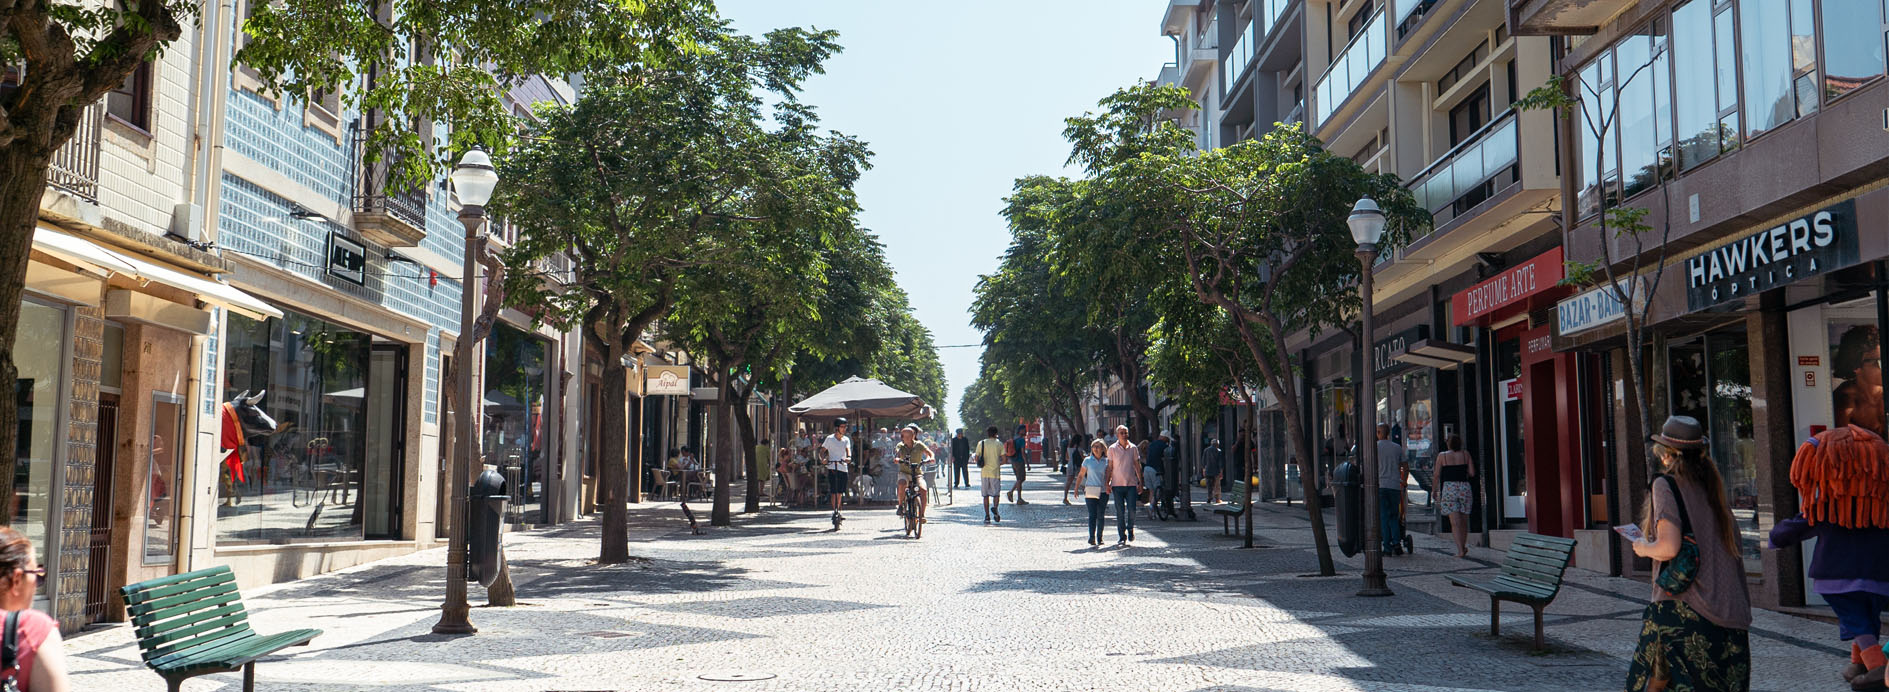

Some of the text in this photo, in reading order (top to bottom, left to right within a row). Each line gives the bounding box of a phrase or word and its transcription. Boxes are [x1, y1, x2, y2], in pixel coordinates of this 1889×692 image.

[1690, 211, 1834, 289] HAWKERS
[1467, 263, 1536, 316] PERFUME ARTE
[1712, 258, 1817, 300] ÓPTICA
